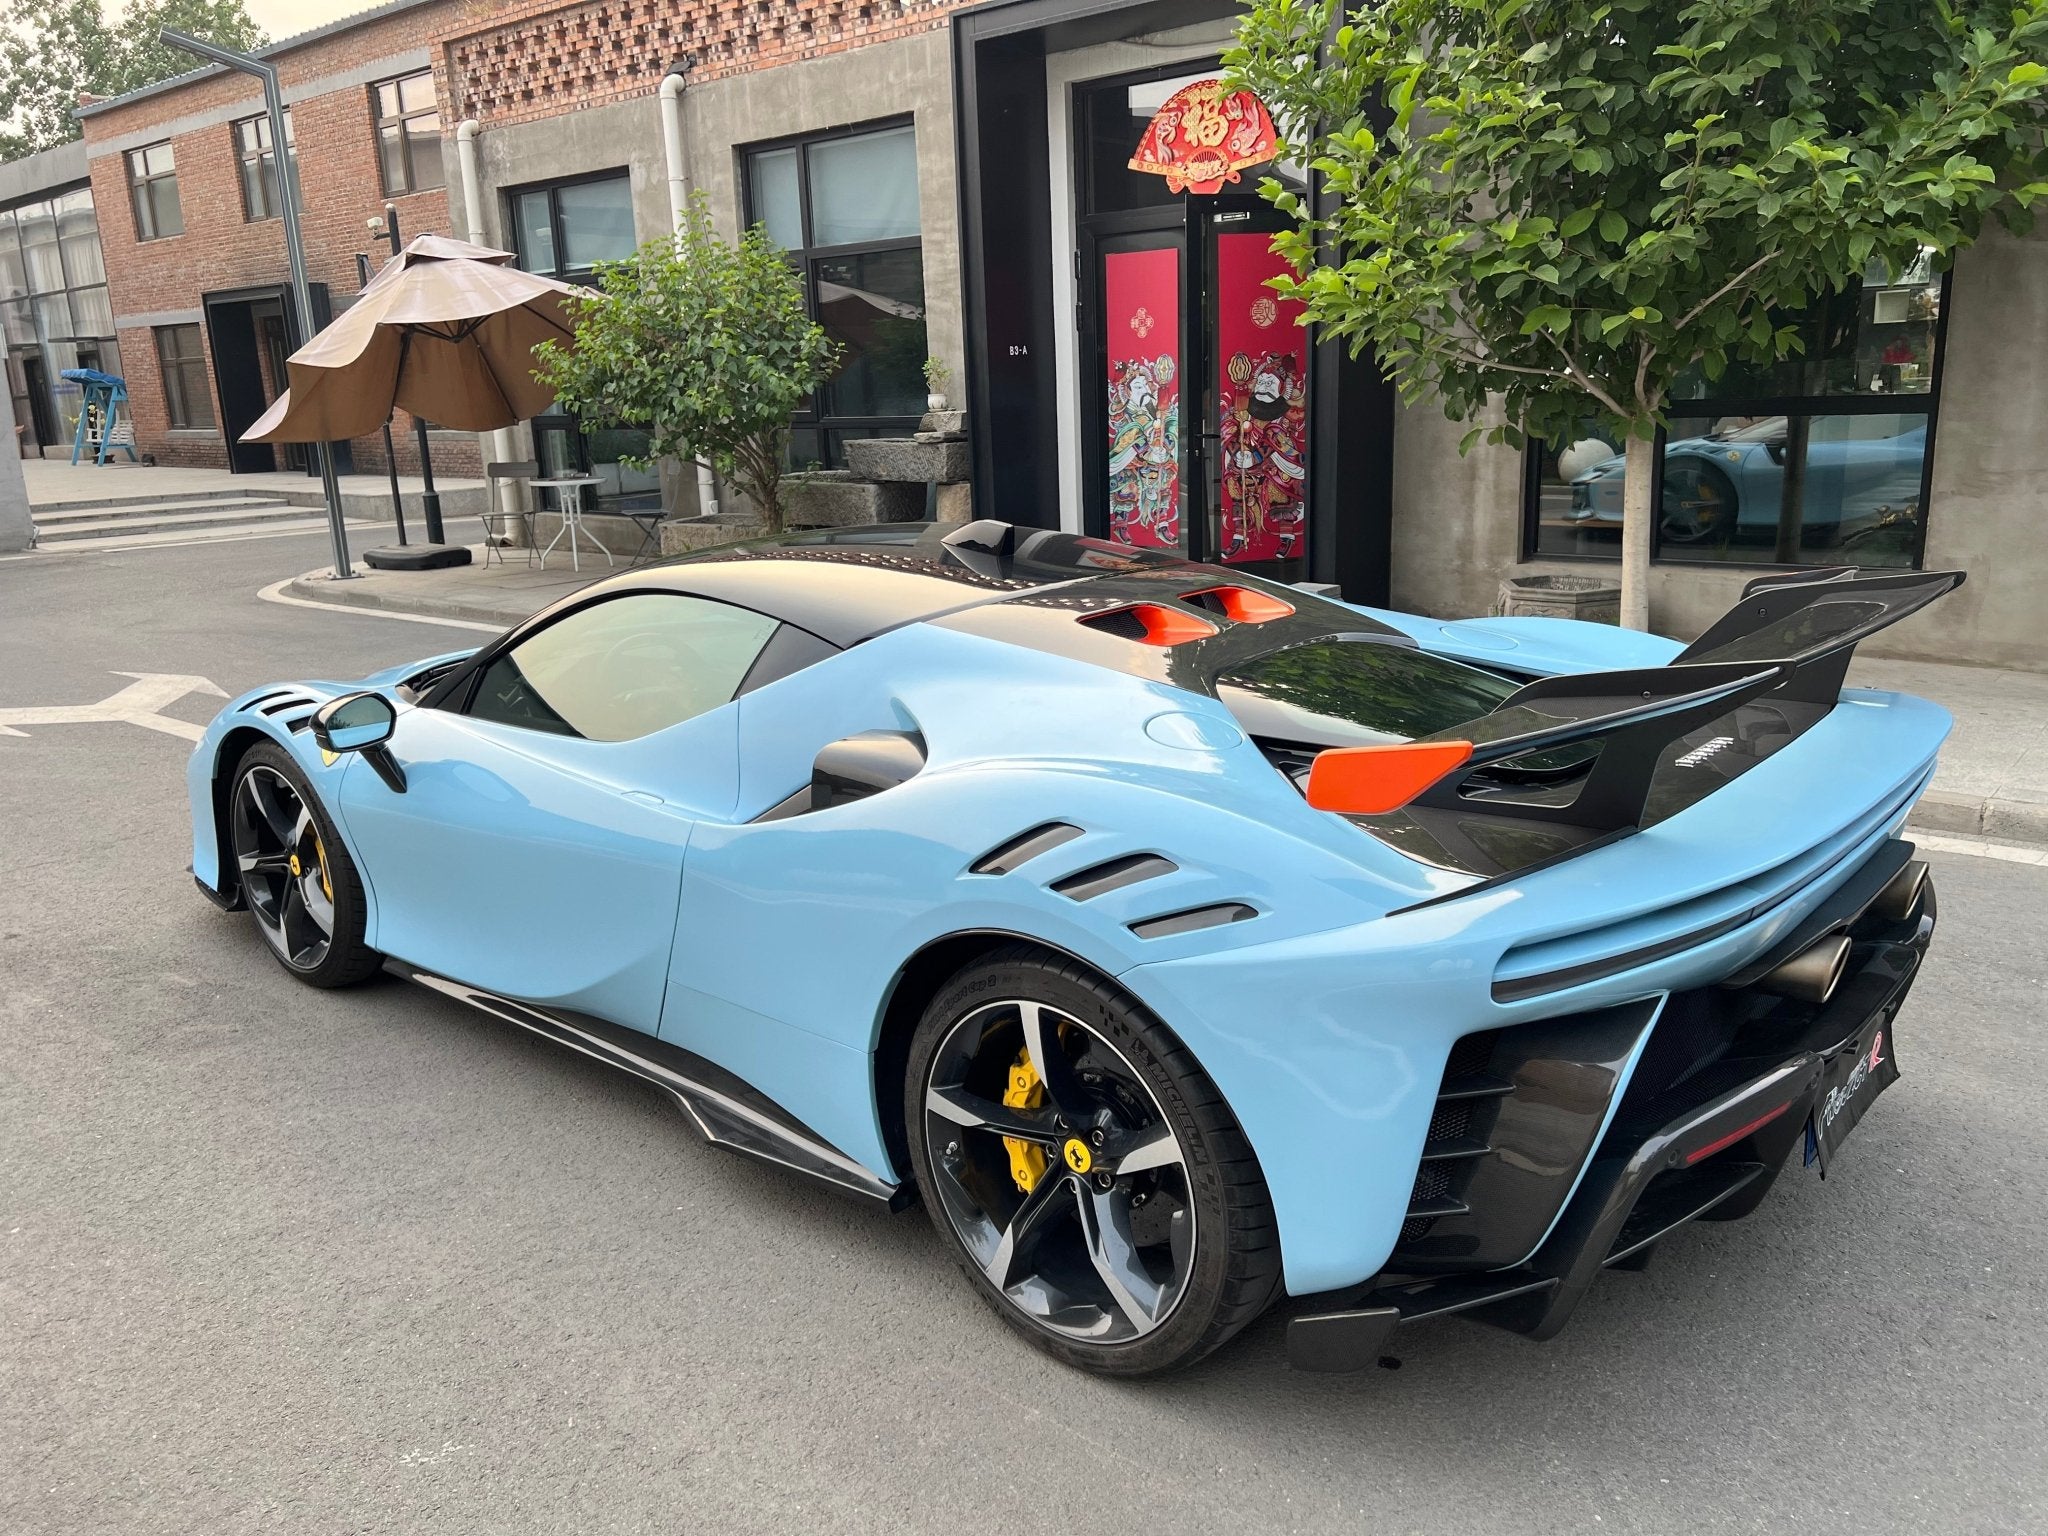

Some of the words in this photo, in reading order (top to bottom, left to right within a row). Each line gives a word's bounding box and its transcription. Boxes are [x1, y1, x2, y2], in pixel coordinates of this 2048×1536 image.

[1181, 84, 1230, 147] 福
[1009, 345, 1028, 356] B3-A
[968, 980, 987, 994] Cup
[987, 974, 997, 988] 2
[1148, 1061, 1208, 1164] MICHELIN
